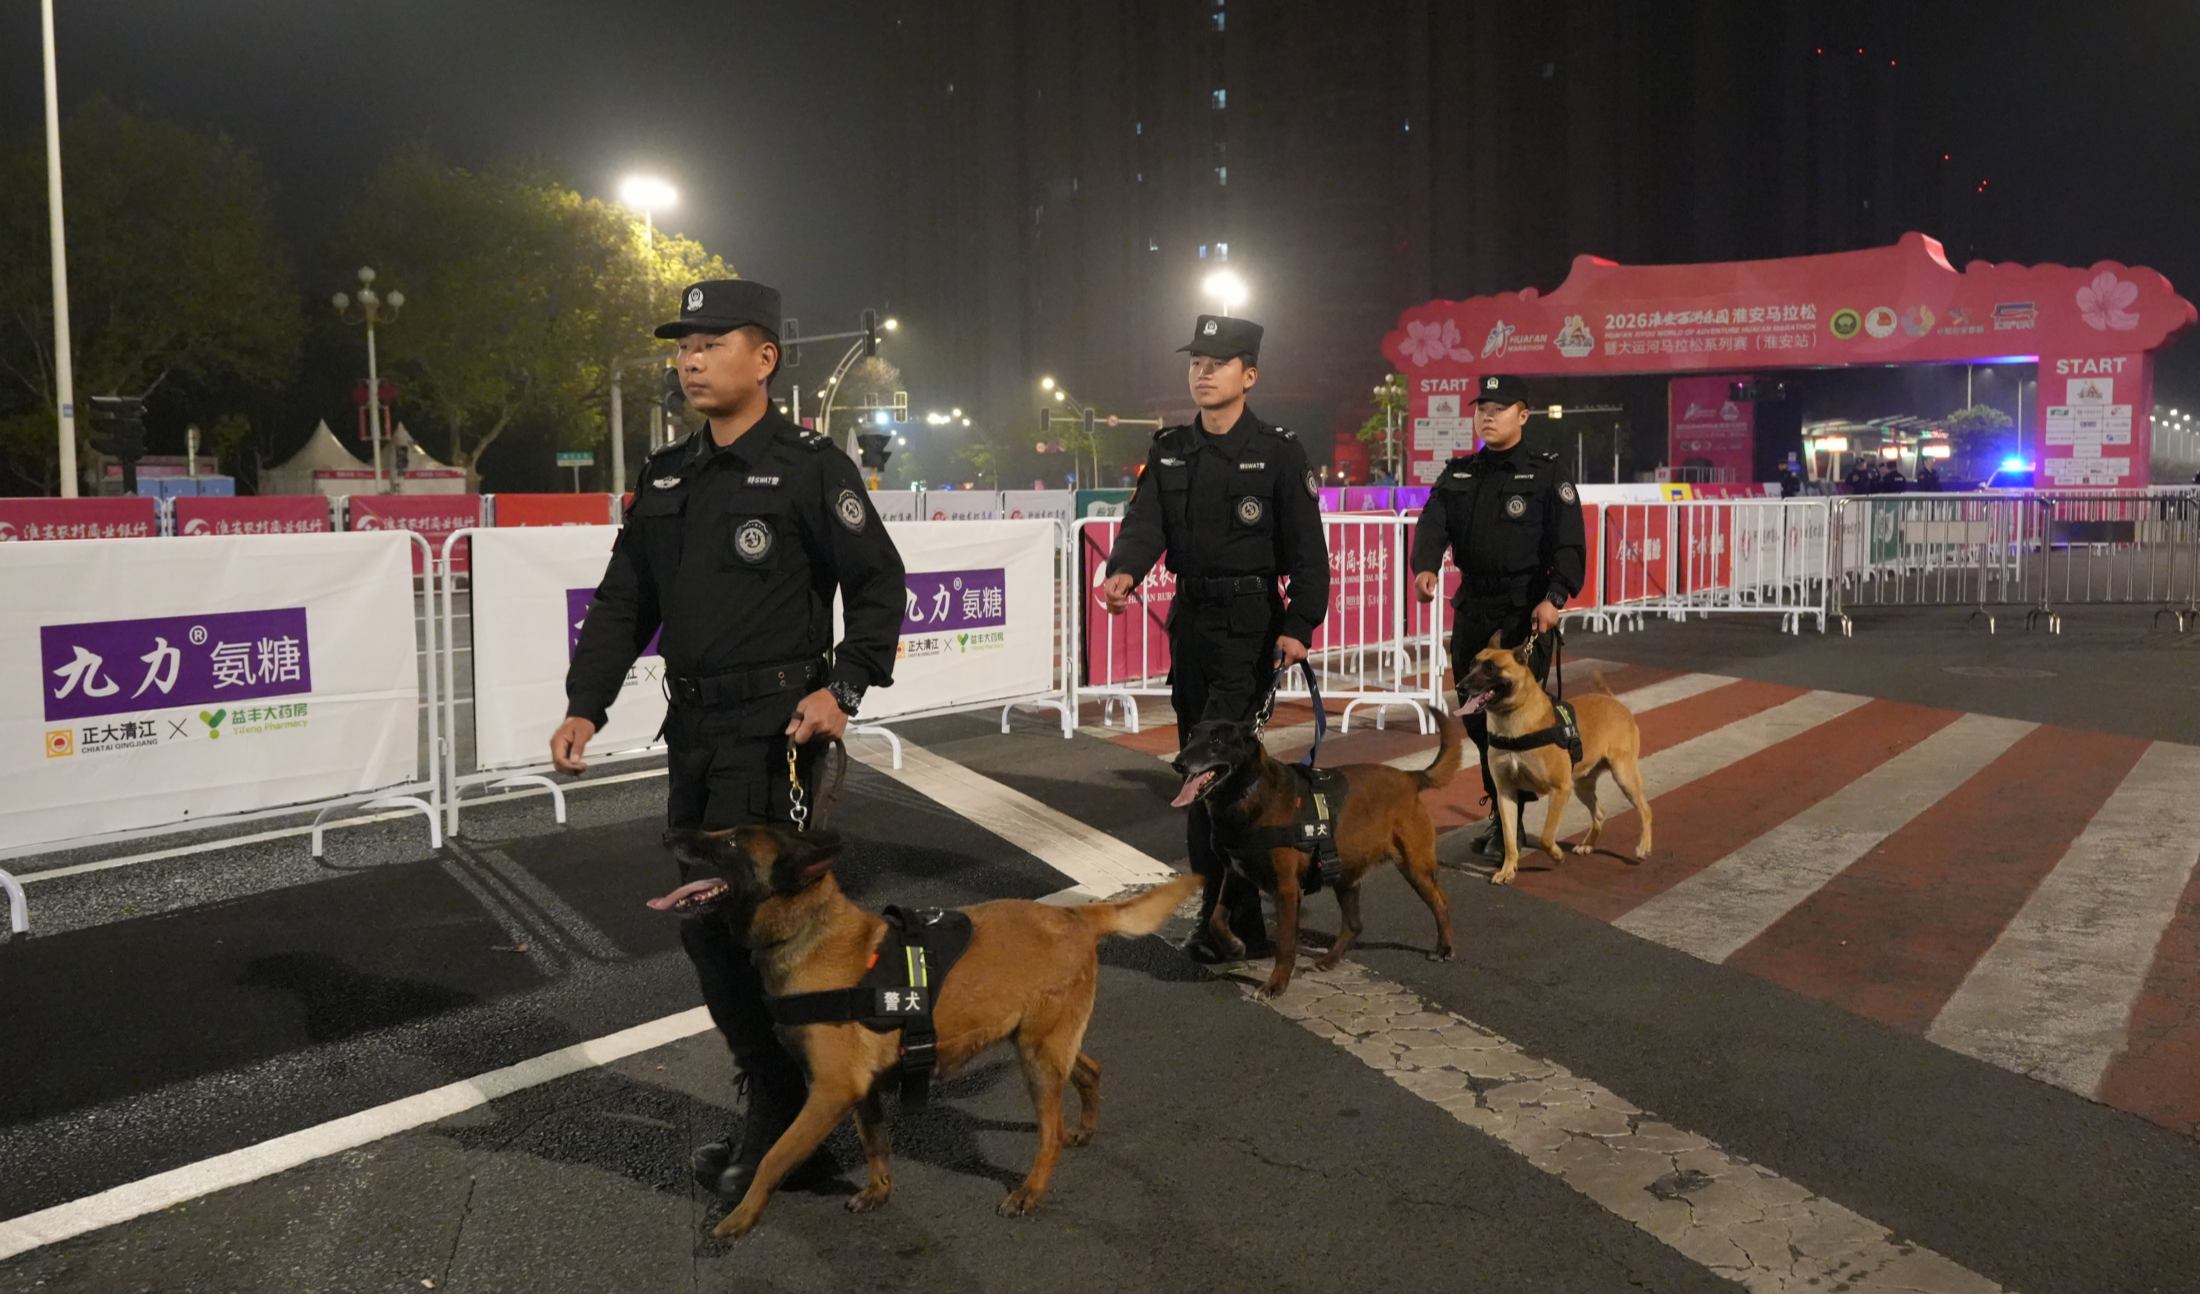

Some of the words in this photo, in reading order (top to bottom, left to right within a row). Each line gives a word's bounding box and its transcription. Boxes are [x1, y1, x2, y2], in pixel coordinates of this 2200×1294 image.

[1732, 304, 1816, 324] 淮安马拉松
[2056, 357, 2127, 374] START
[1420, 378, 1469, 392] START
[908, 638, 939, 652] 正大清江
[81, 720, 157, 745] 正大清江
[232, 703, 308, 725] 益丰大药房
[884, 991, 920, 1011] 警犬
